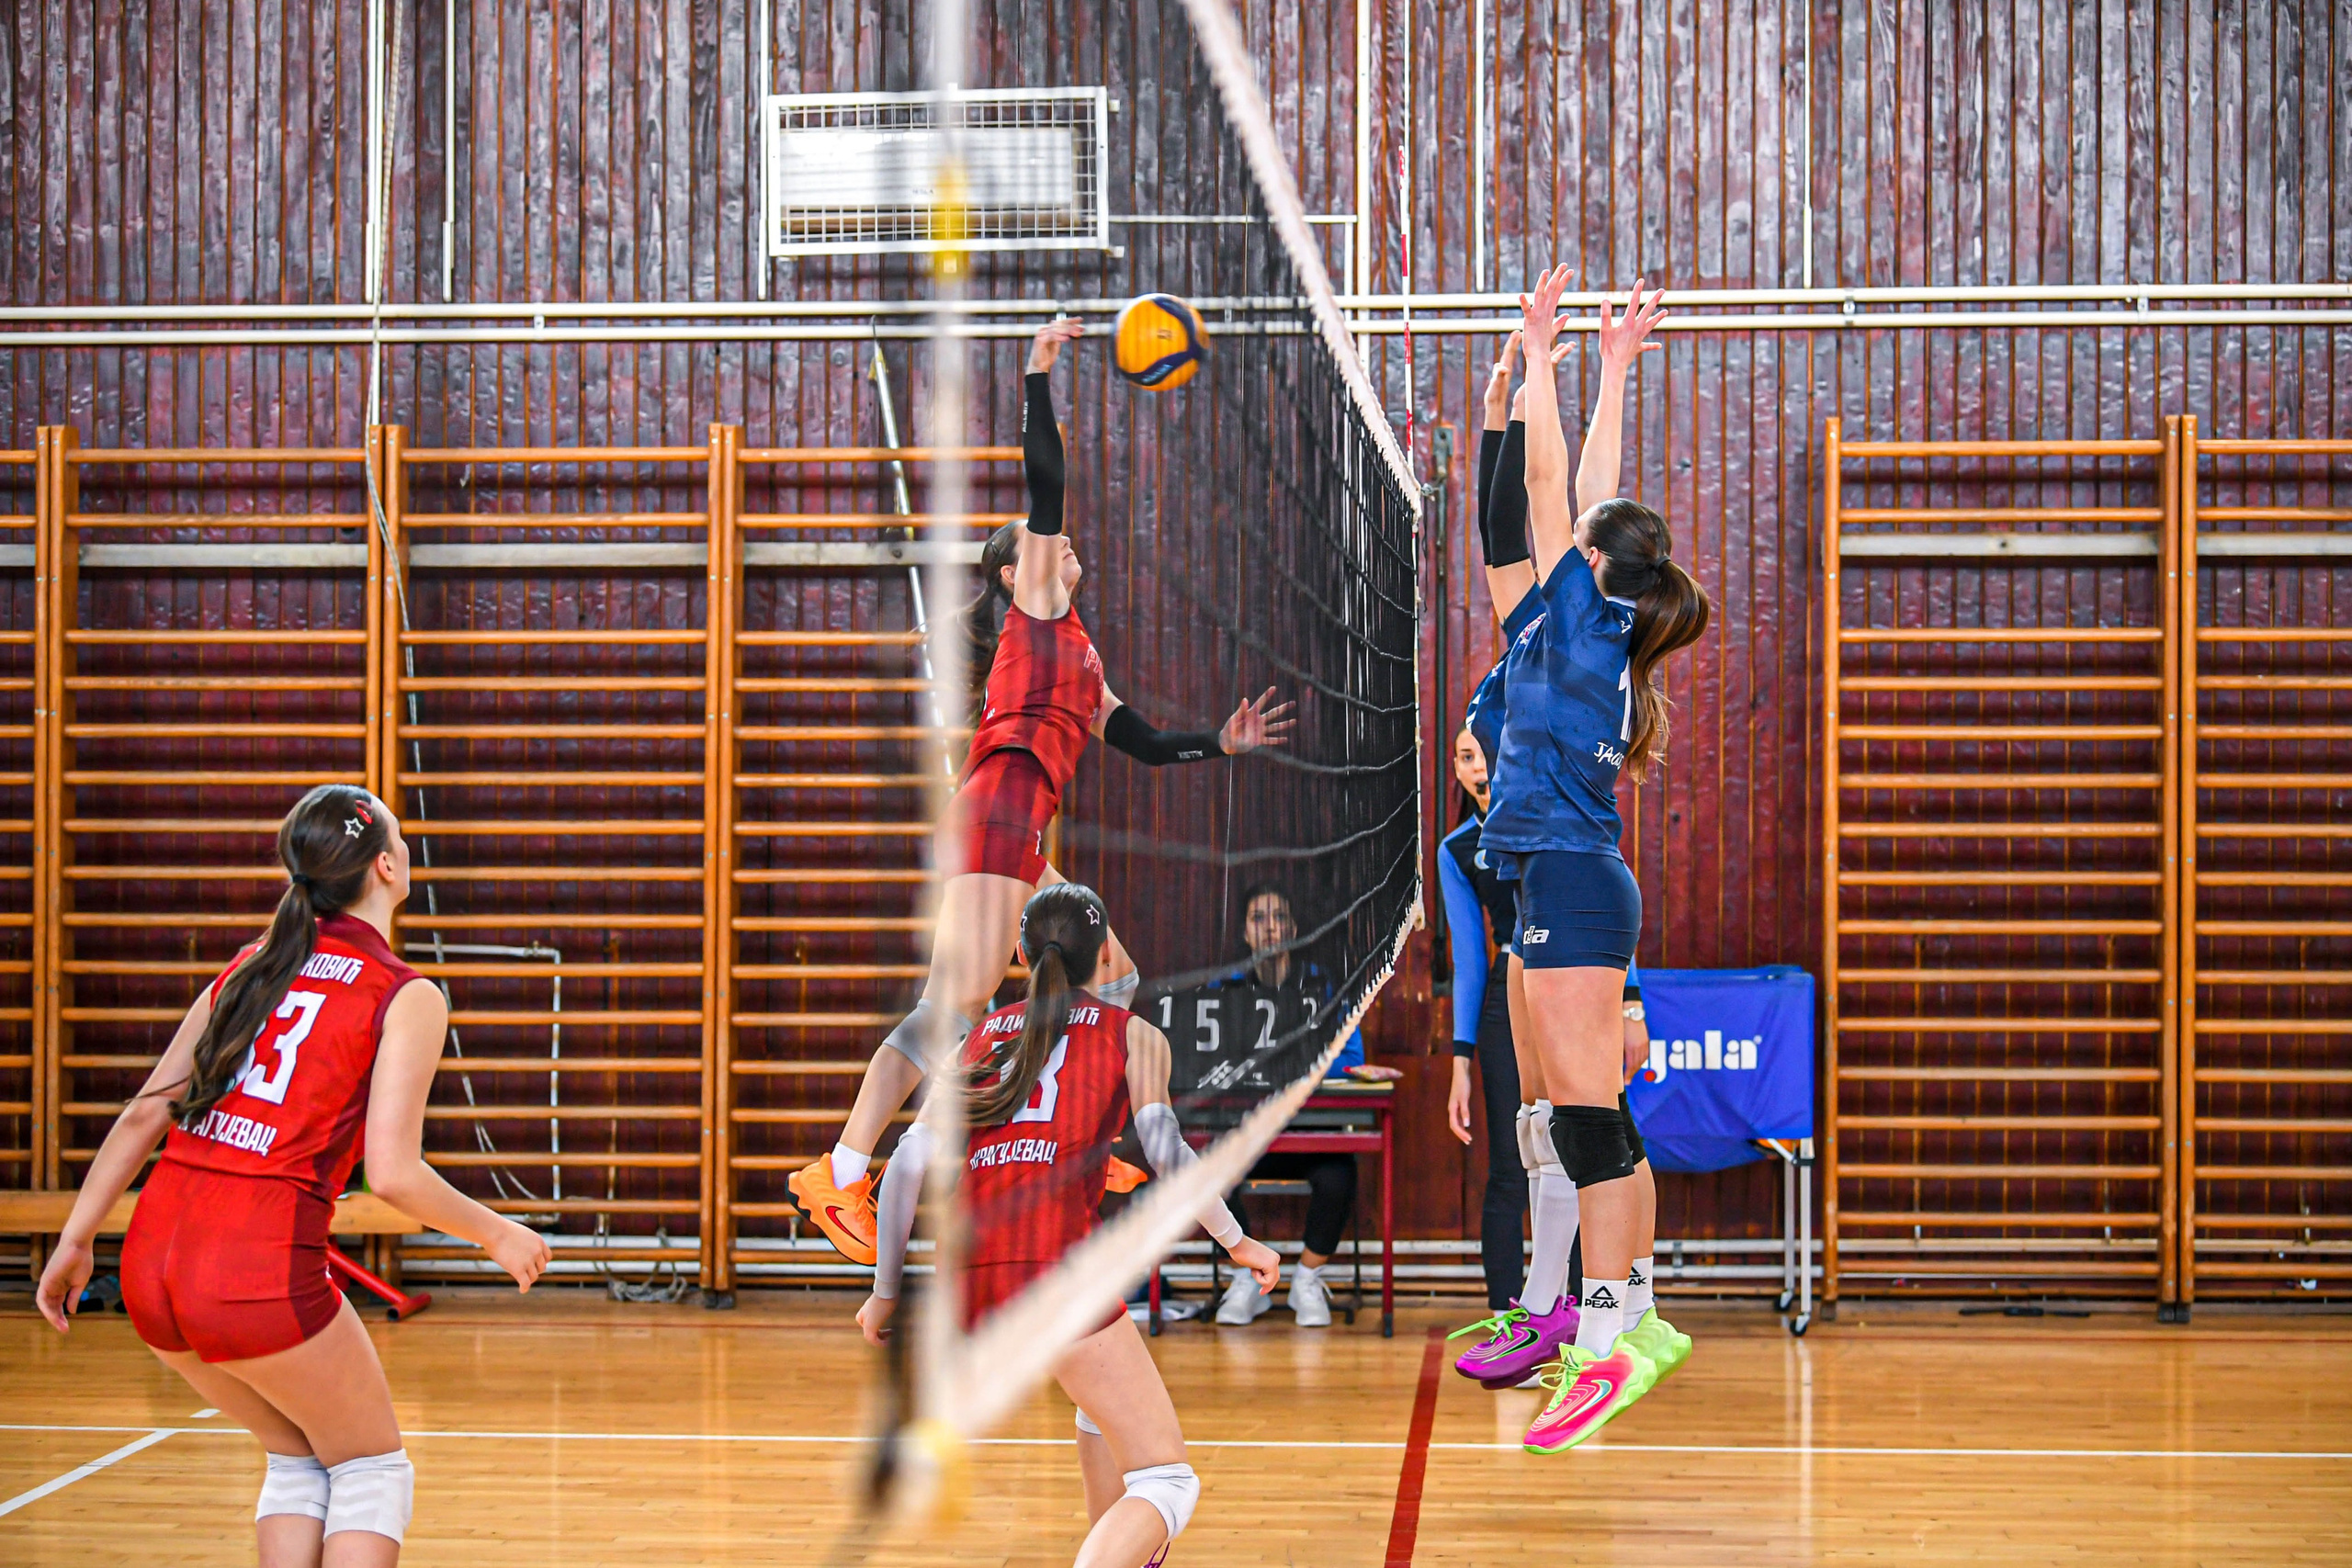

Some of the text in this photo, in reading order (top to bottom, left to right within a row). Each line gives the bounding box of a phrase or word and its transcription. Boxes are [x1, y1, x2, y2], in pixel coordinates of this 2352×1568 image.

[300, 953, 364, 985] КОВИЋ
[1159, 996, 1172, 1028] 1
[1196, 999, 1220, 1051] 5
[1254, 998, 1276, 1049] 2
[235, 990, 327, 1106] 3
[1628, 1277, 1647, 1287] AK
[1585, 1298, 1620, 1309] PEAK
